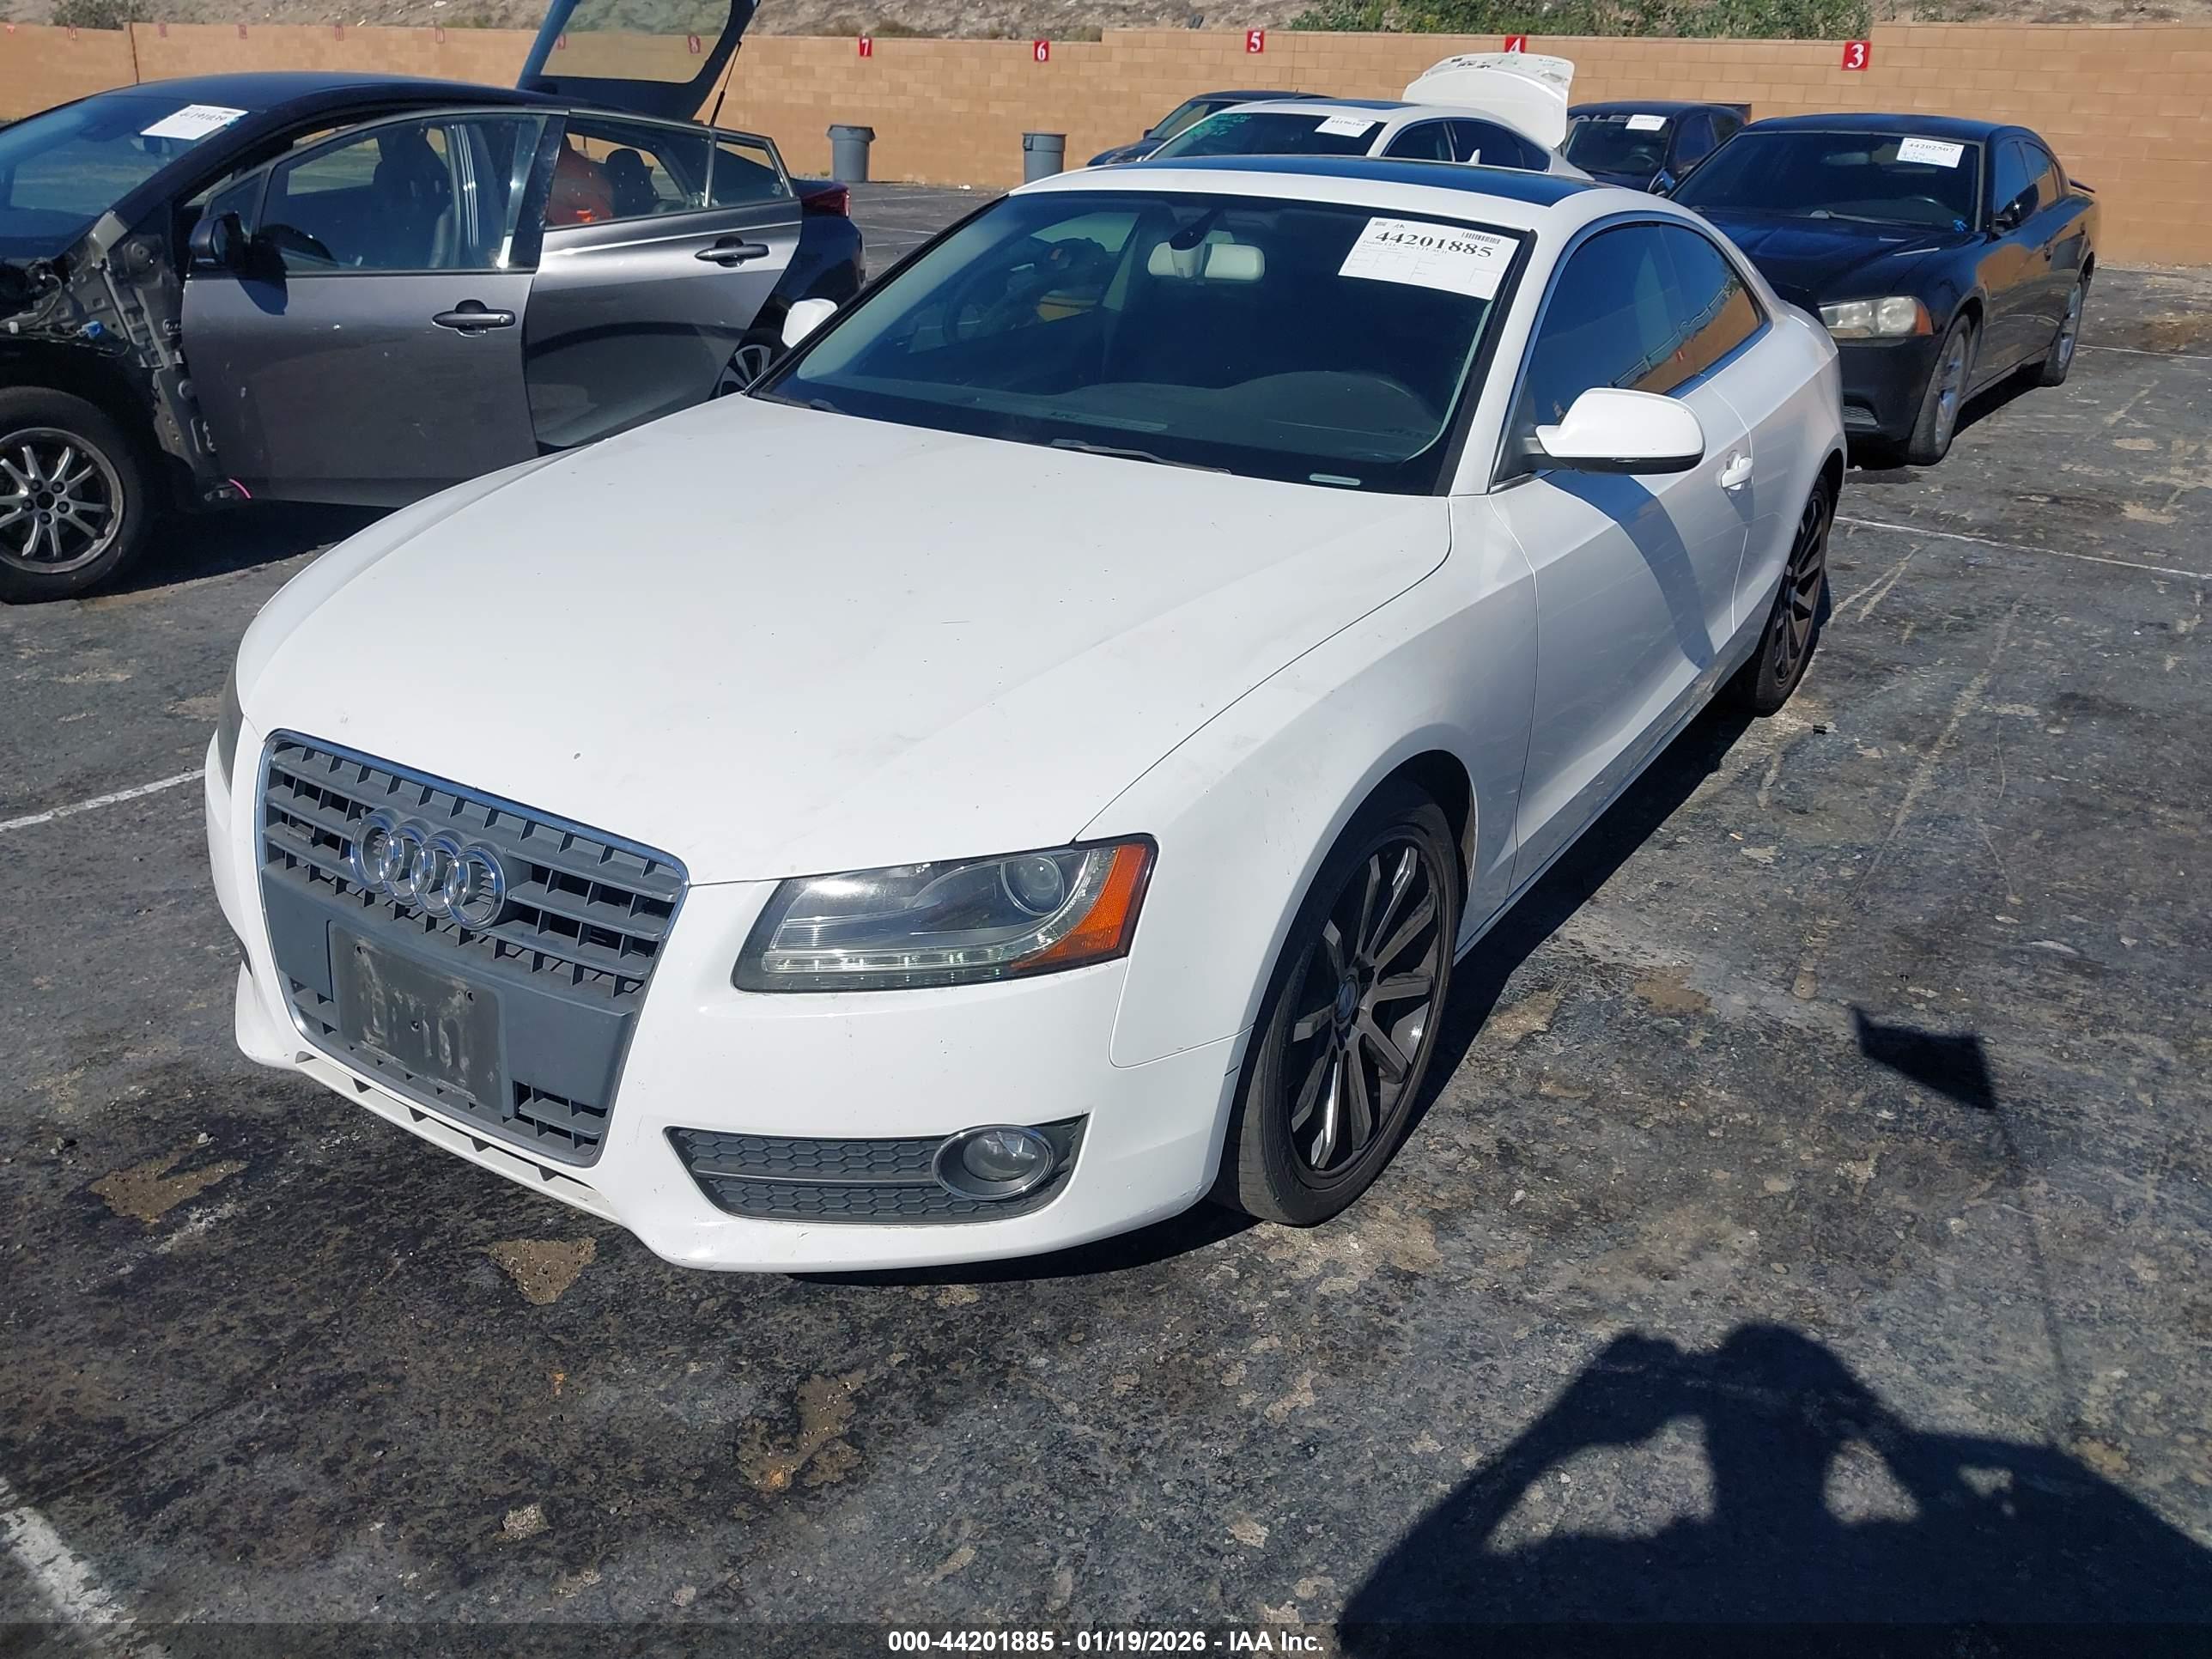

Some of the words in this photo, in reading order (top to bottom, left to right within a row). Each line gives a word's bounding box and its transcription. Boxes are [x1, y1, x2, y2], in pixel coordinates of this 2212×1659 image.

[861, 39, 870, 57] 7
[1036, 42, 1047, 61] 6
[1250, 32, 1261, 52] 5
[1509, 37, 1521, 54] 4
[1847, 44, 1864, 69] 3
[1375, 231, 1494, 258] 44201885
